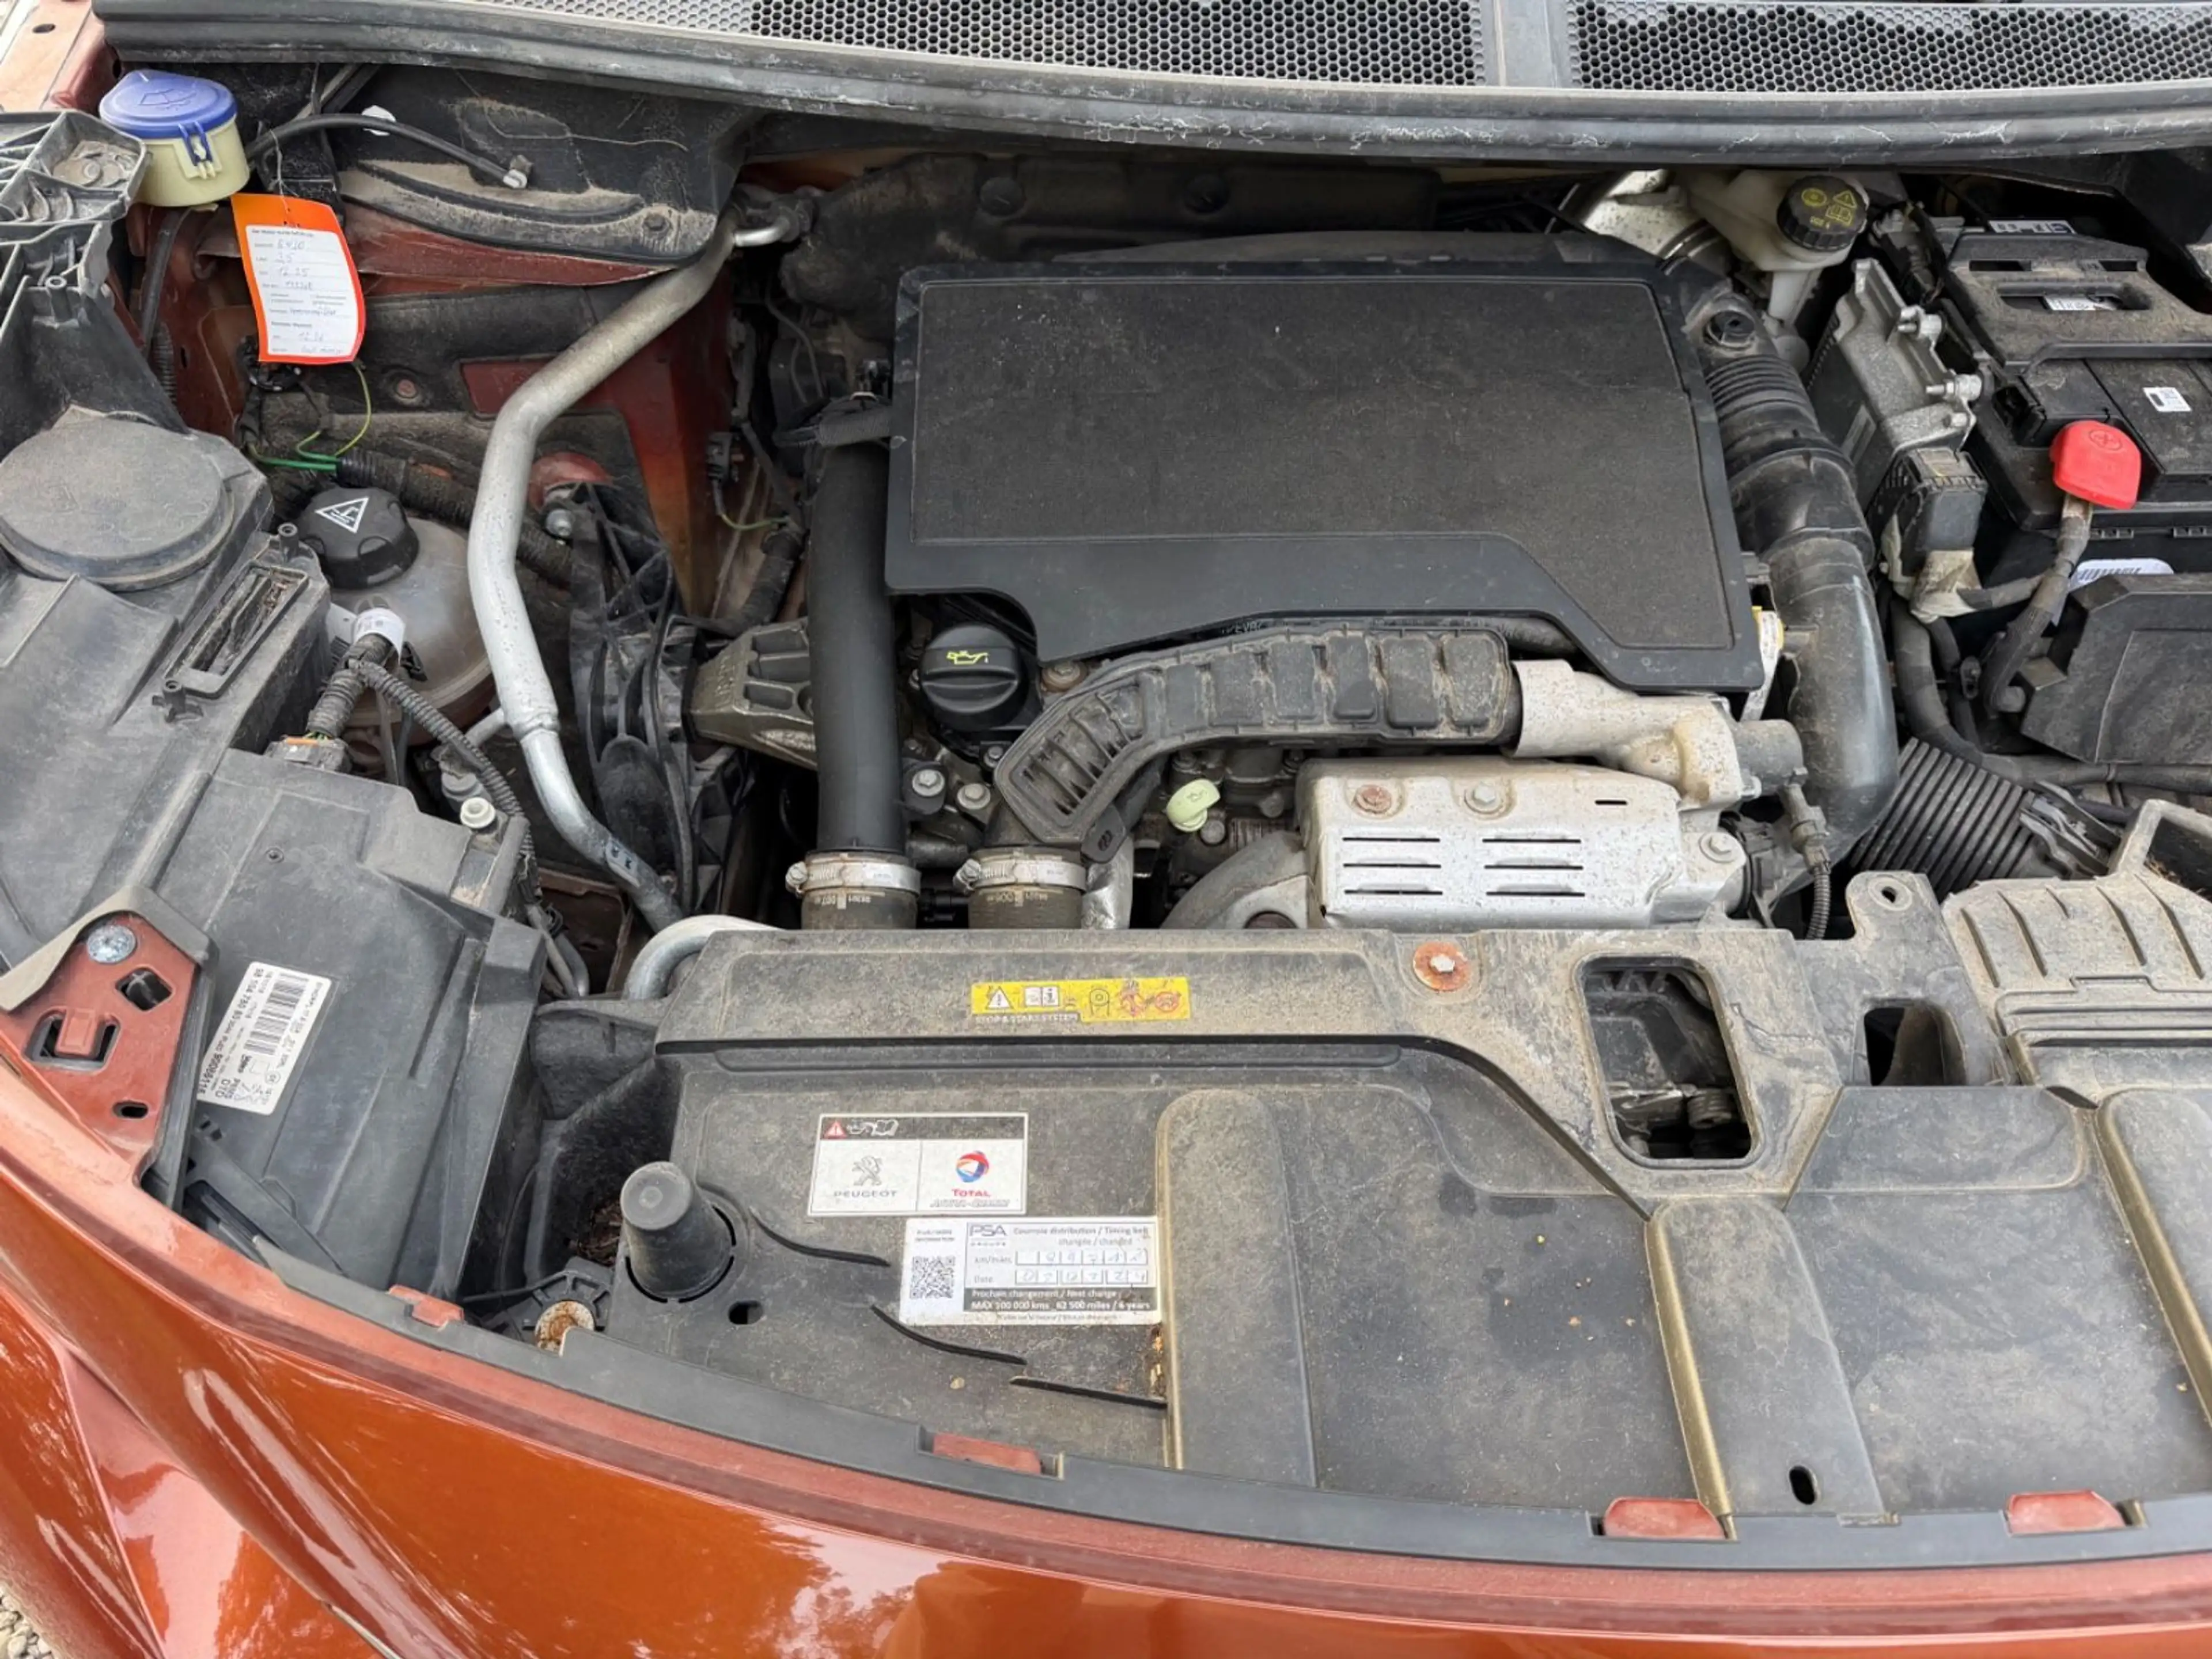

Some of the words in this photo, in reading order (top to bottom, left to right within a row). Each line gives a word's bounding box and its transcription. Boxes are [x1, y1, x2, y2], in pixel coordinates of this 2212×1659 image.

[834, 1190, 897, 1198] PEUGEOT
[952, 1188, 991, 1196] TOTAL
[969, 1224, 1007, 1237] PSA
